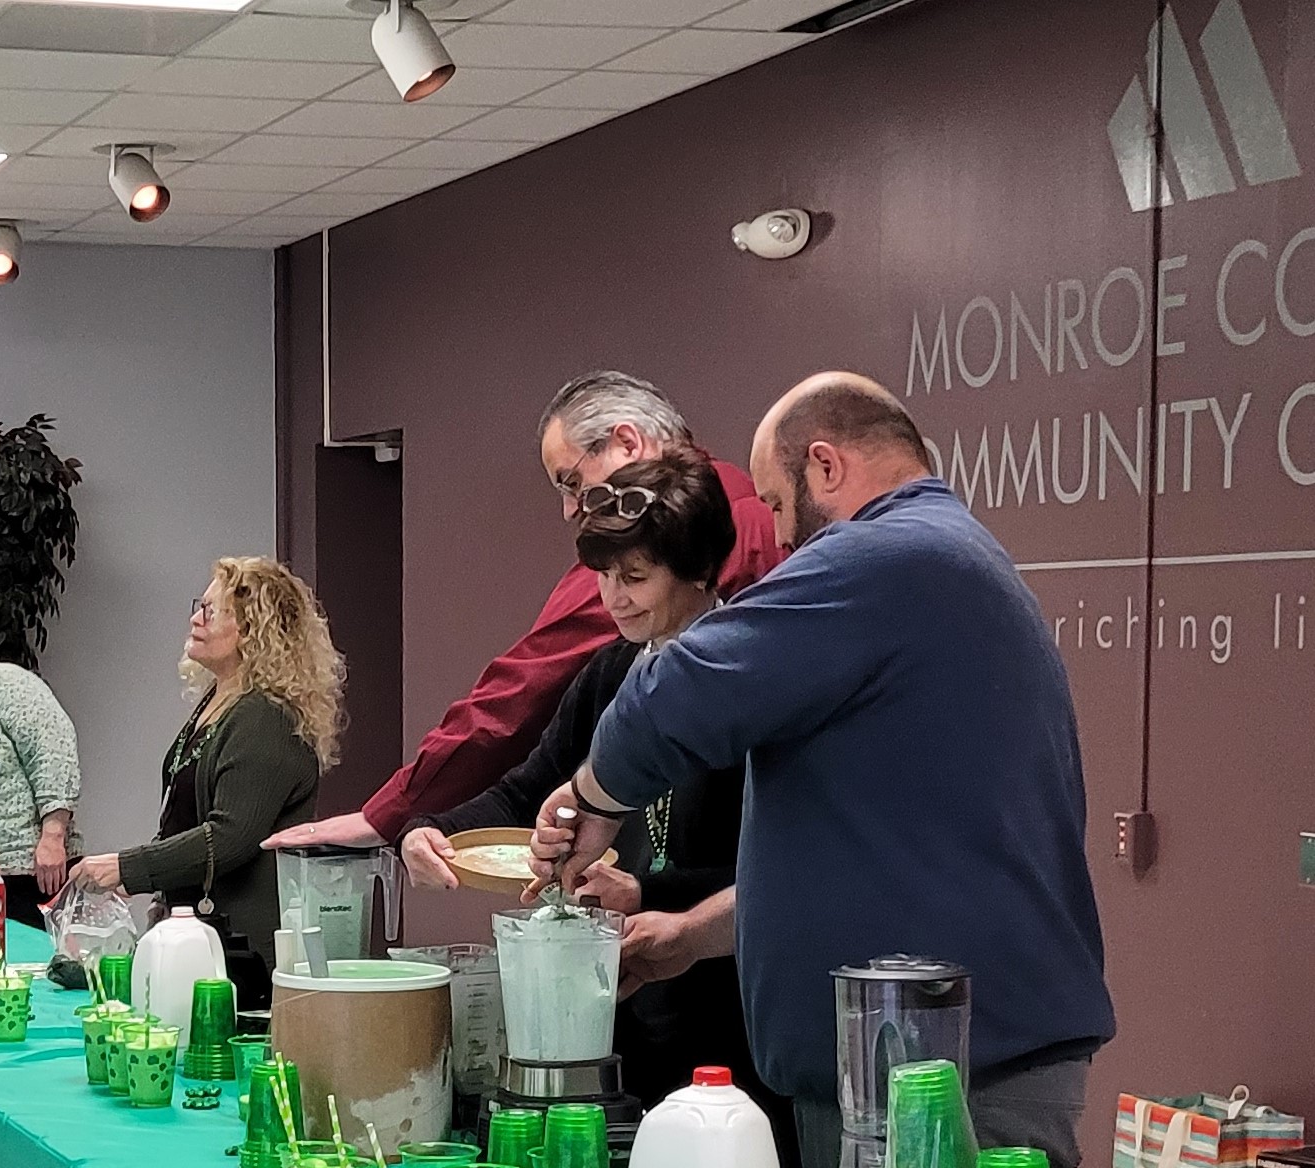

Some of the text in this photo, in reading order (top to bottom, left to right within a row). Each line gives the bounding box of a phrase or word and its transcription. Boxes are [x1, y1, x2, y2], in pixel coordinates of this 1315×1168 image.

[905, 255, 1188, 397] MONROE
[922, 392, 1253, 509] MMUNITY
[1054, 595, 1233, 665] riching
